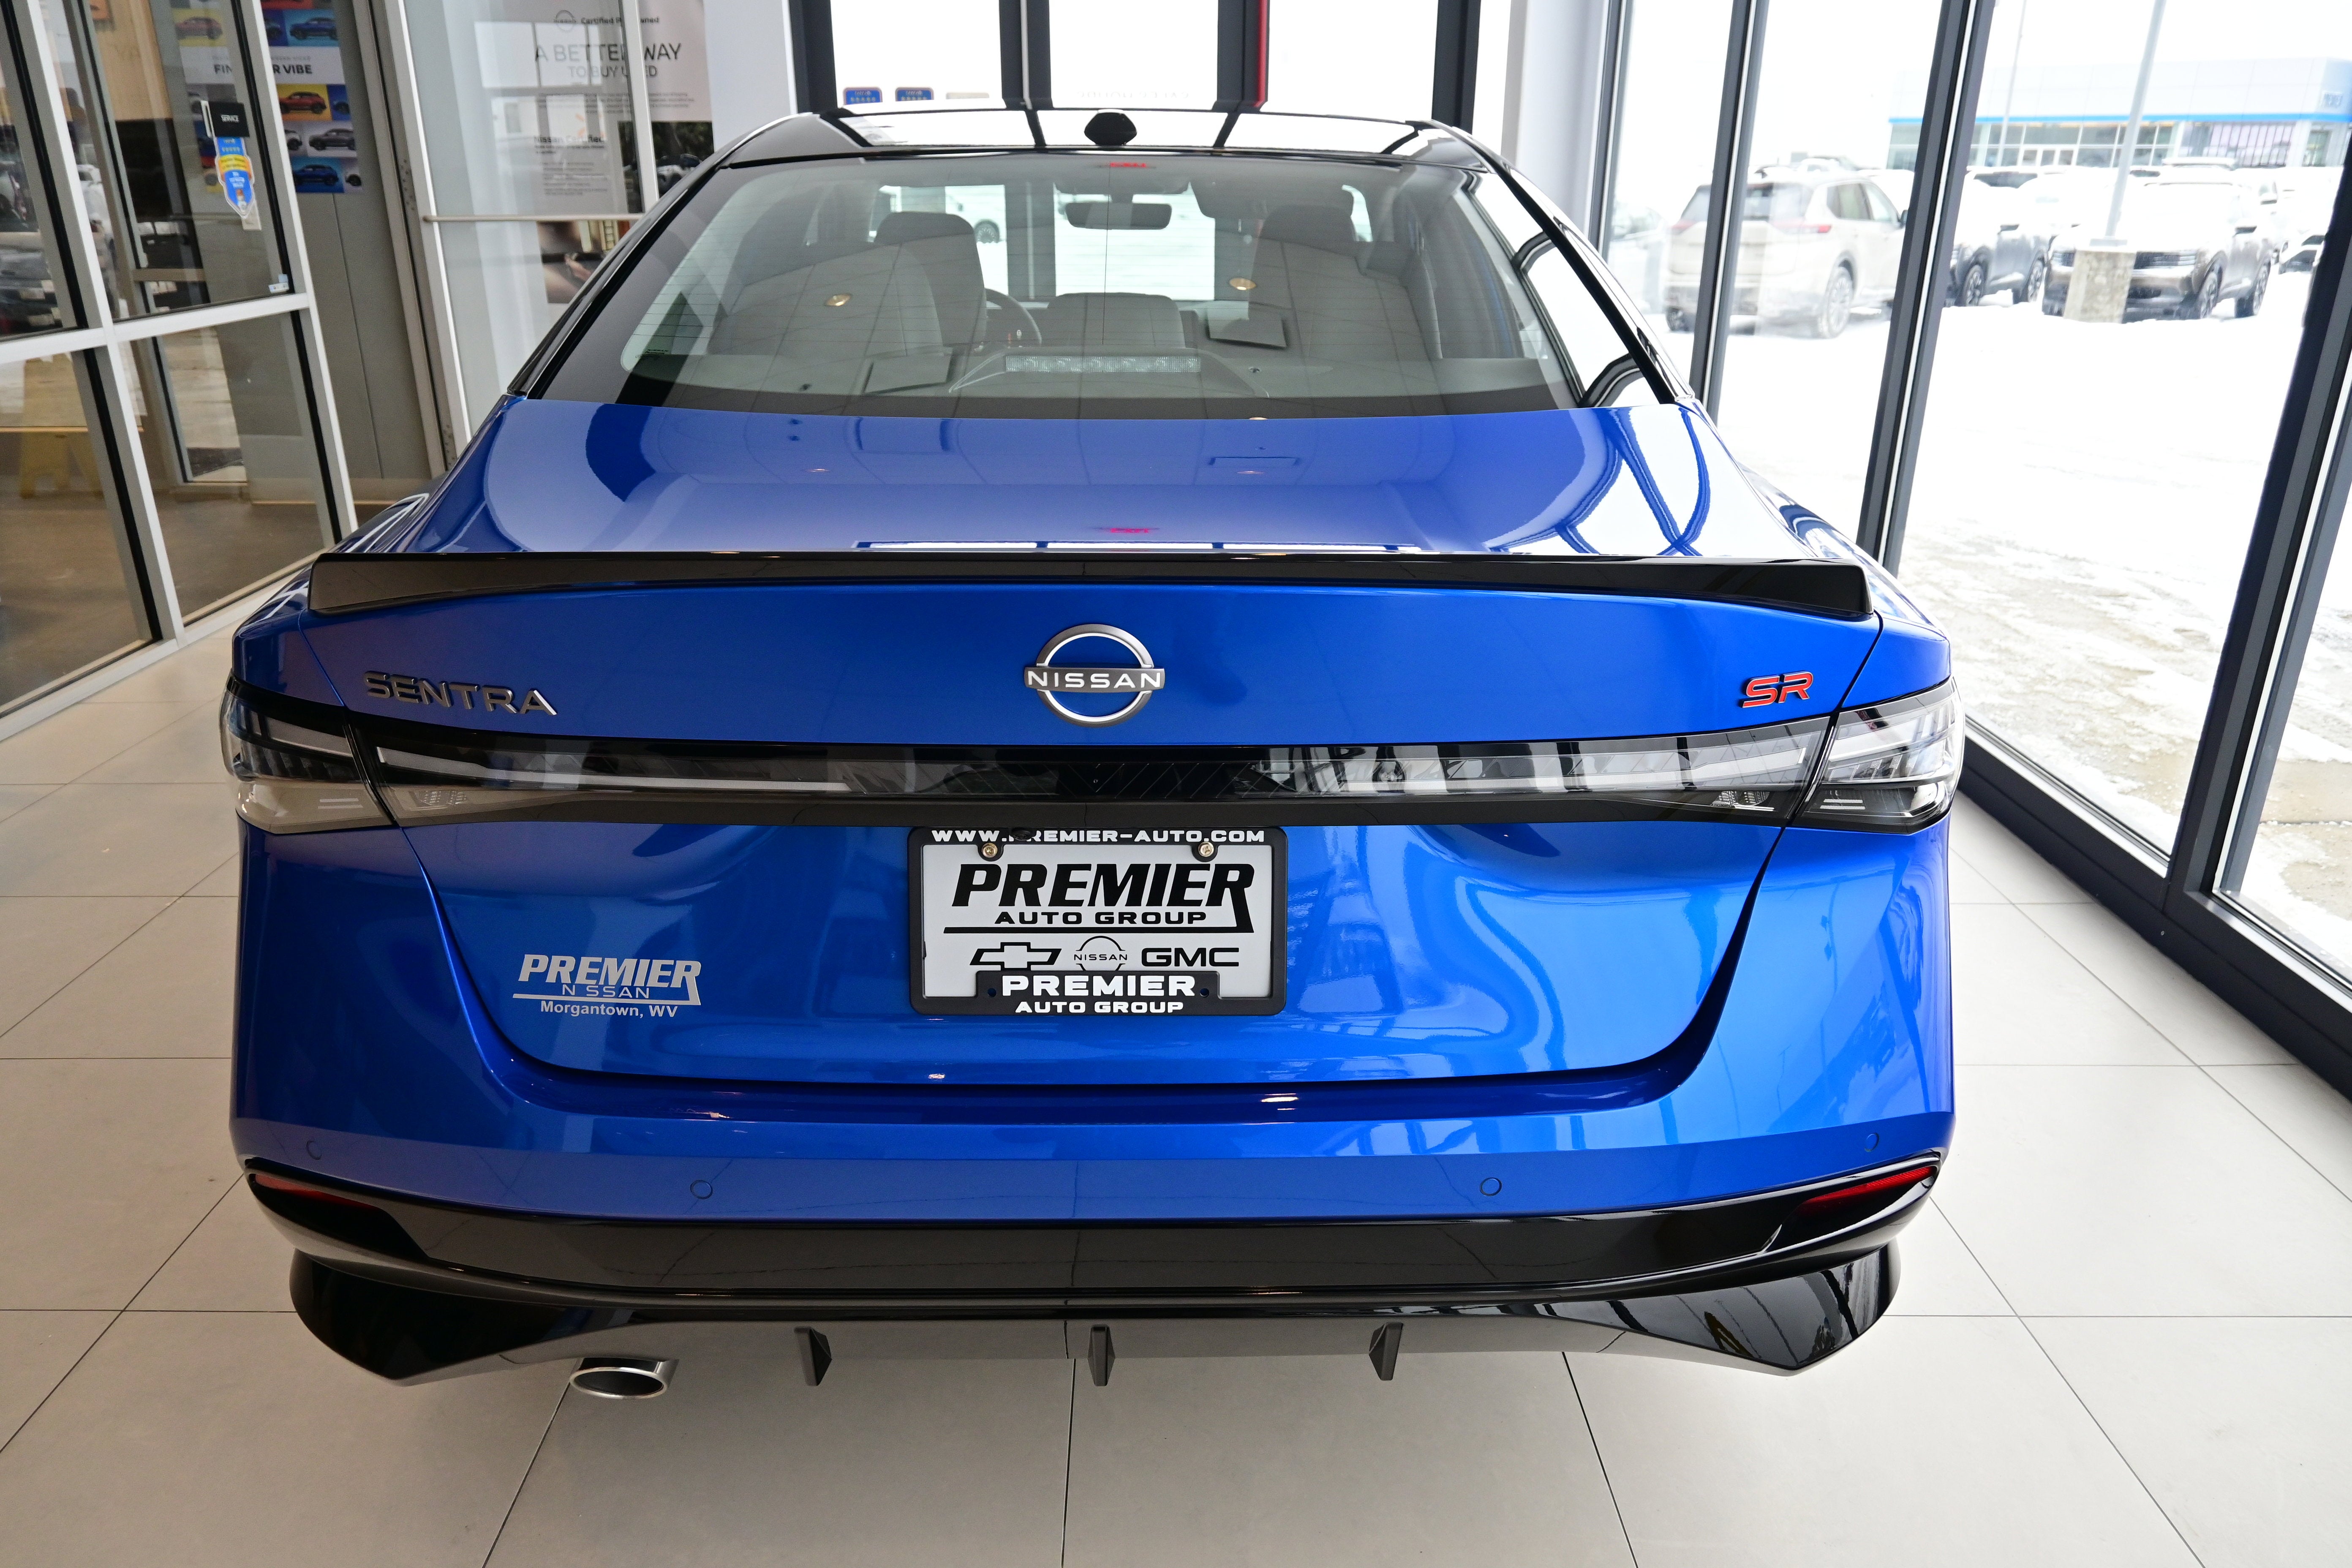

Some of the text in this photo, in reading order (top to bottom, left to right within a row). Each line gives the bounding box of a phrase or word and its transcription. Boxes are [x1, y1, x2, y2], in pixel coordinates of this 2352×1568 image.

[535, 44, 548, 61] A
[283, 65, 313, 74] VIBE
[592, 66, 618, 77] BUY
[1028, 671, 1160, 688] NISSAN
[364, 670, 557, 715] SENTRA
[1742, 671, 1813, 708] SR
[952, 864, 1255, 933] PREMIER
[994, 912, 1206, 924] AUTO GROUP
[1141, 947, 1239, 967] GMC
[518, 954, 701, 1005] PREMIER
[1002, 975, 1195, 996] PREMIER
[562, 984, 649, 999] NSSAN
[541, 1001, 678, 1018] Morgantown, WV
[1015, 1002, 1183, 1013] AUTO GROUP
